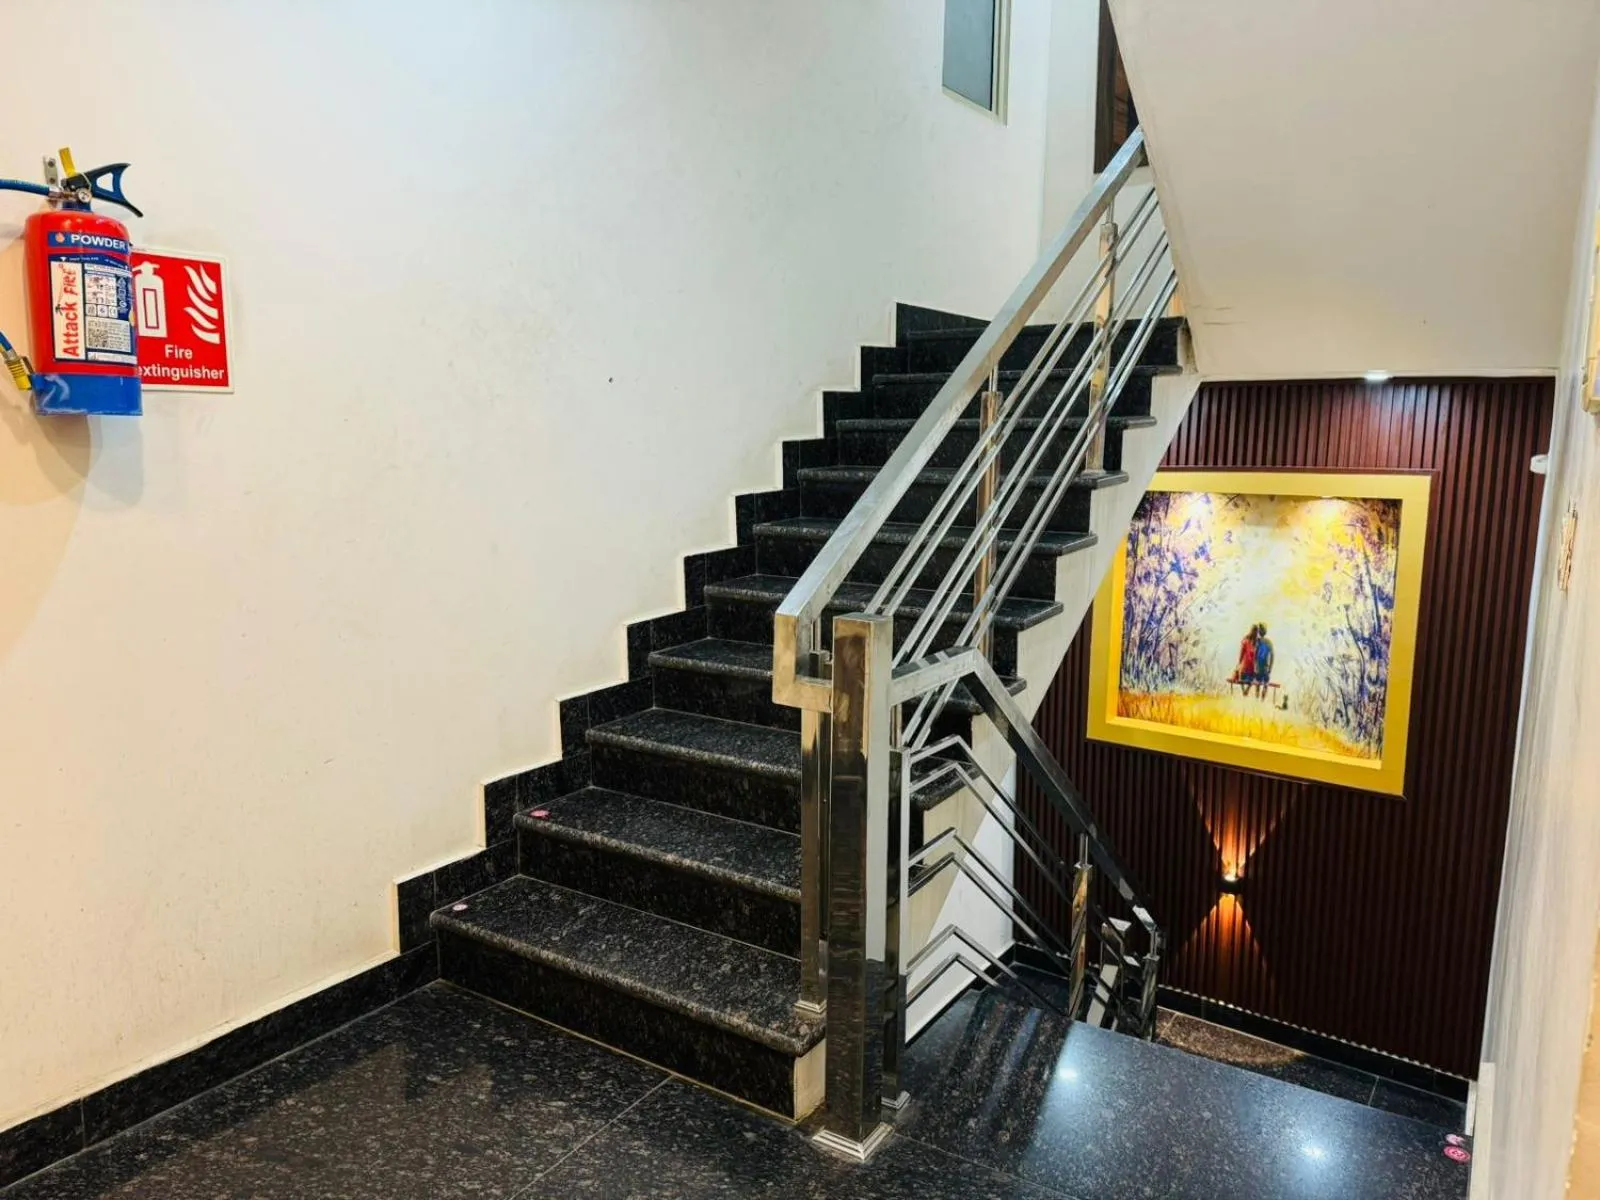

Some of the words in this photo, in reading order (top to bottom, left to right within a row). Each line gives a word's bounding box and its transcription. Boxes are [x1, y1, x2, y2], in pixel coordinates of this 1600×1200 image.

[71, 233, 125, 250] POWDER
[61, 303, 79, 357] Attack
[165, 343, 193, 360] Fire
